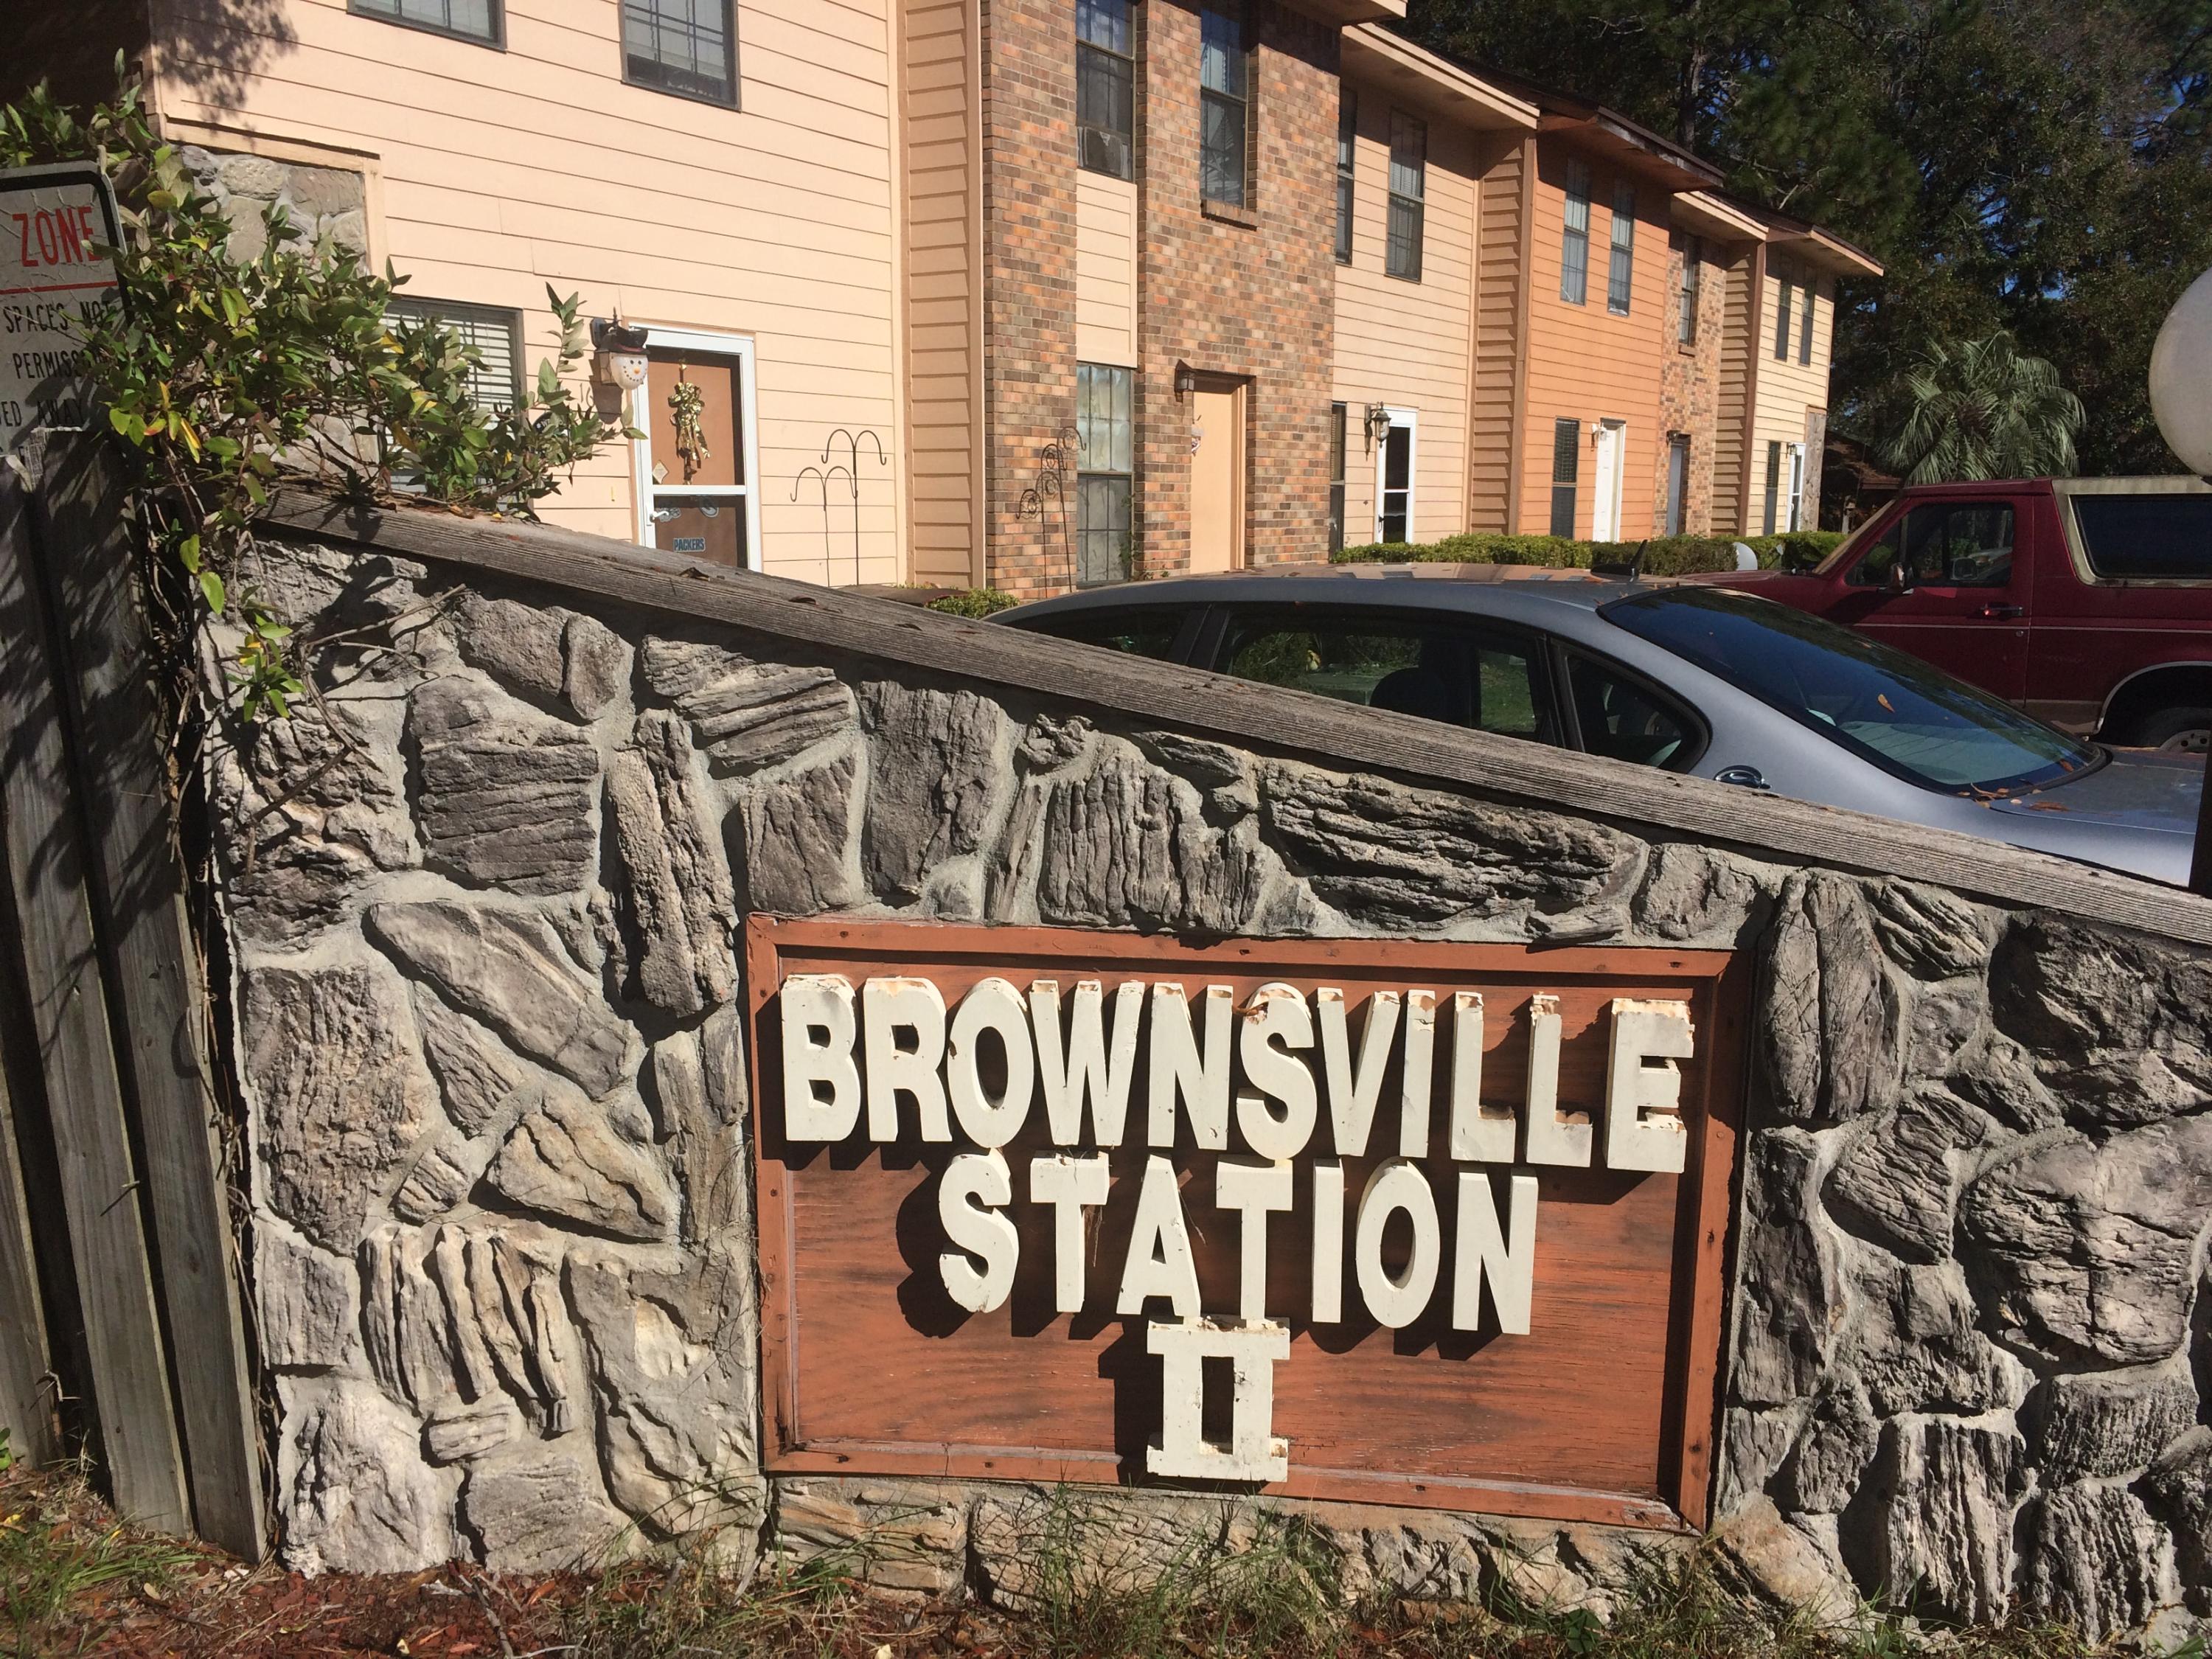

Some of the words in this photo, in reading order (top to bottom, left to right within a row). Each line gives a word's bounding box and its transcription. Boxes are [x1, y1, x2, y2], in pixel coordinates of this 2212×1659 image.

[12, 205, 104, 268] ZONE
[3, 300, 69, 334] SPACES
[0, 400, 22, 428] ED
[37, 399, 84, 428] AWAY
[674, 538, 705, 552] PACKERS
[781, 974, 1694, 1174] BROWNSVILLE
[939, 1147, 1538, 1336] STATION
[1147, 1315, 1290, 1483] II
